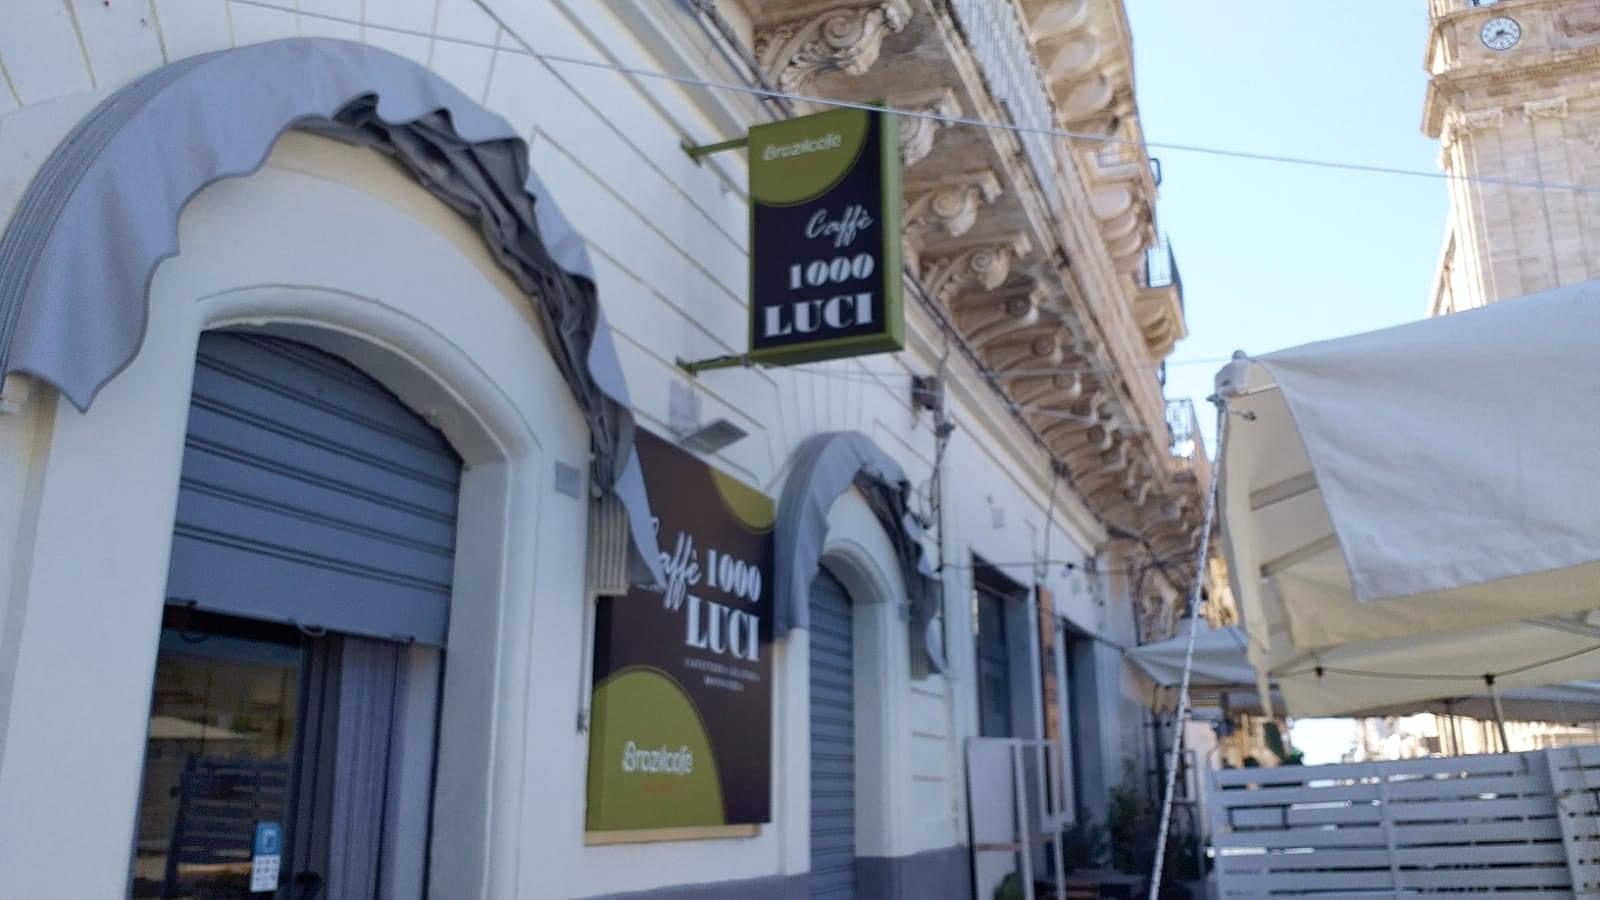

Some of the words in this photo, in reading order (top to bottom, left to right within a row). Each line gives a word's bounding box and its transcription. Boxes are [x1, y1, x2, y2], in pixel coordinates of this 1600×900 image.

[805, 203, 873, 247] Caffè
[790, 253, 874, 290] 1000
[764, 293, 873, 337] LUCI
[651, 517, 702, 611] affè
[707, 548, 761, 602] 1000
[685, 594, 760, 661] LUCI
